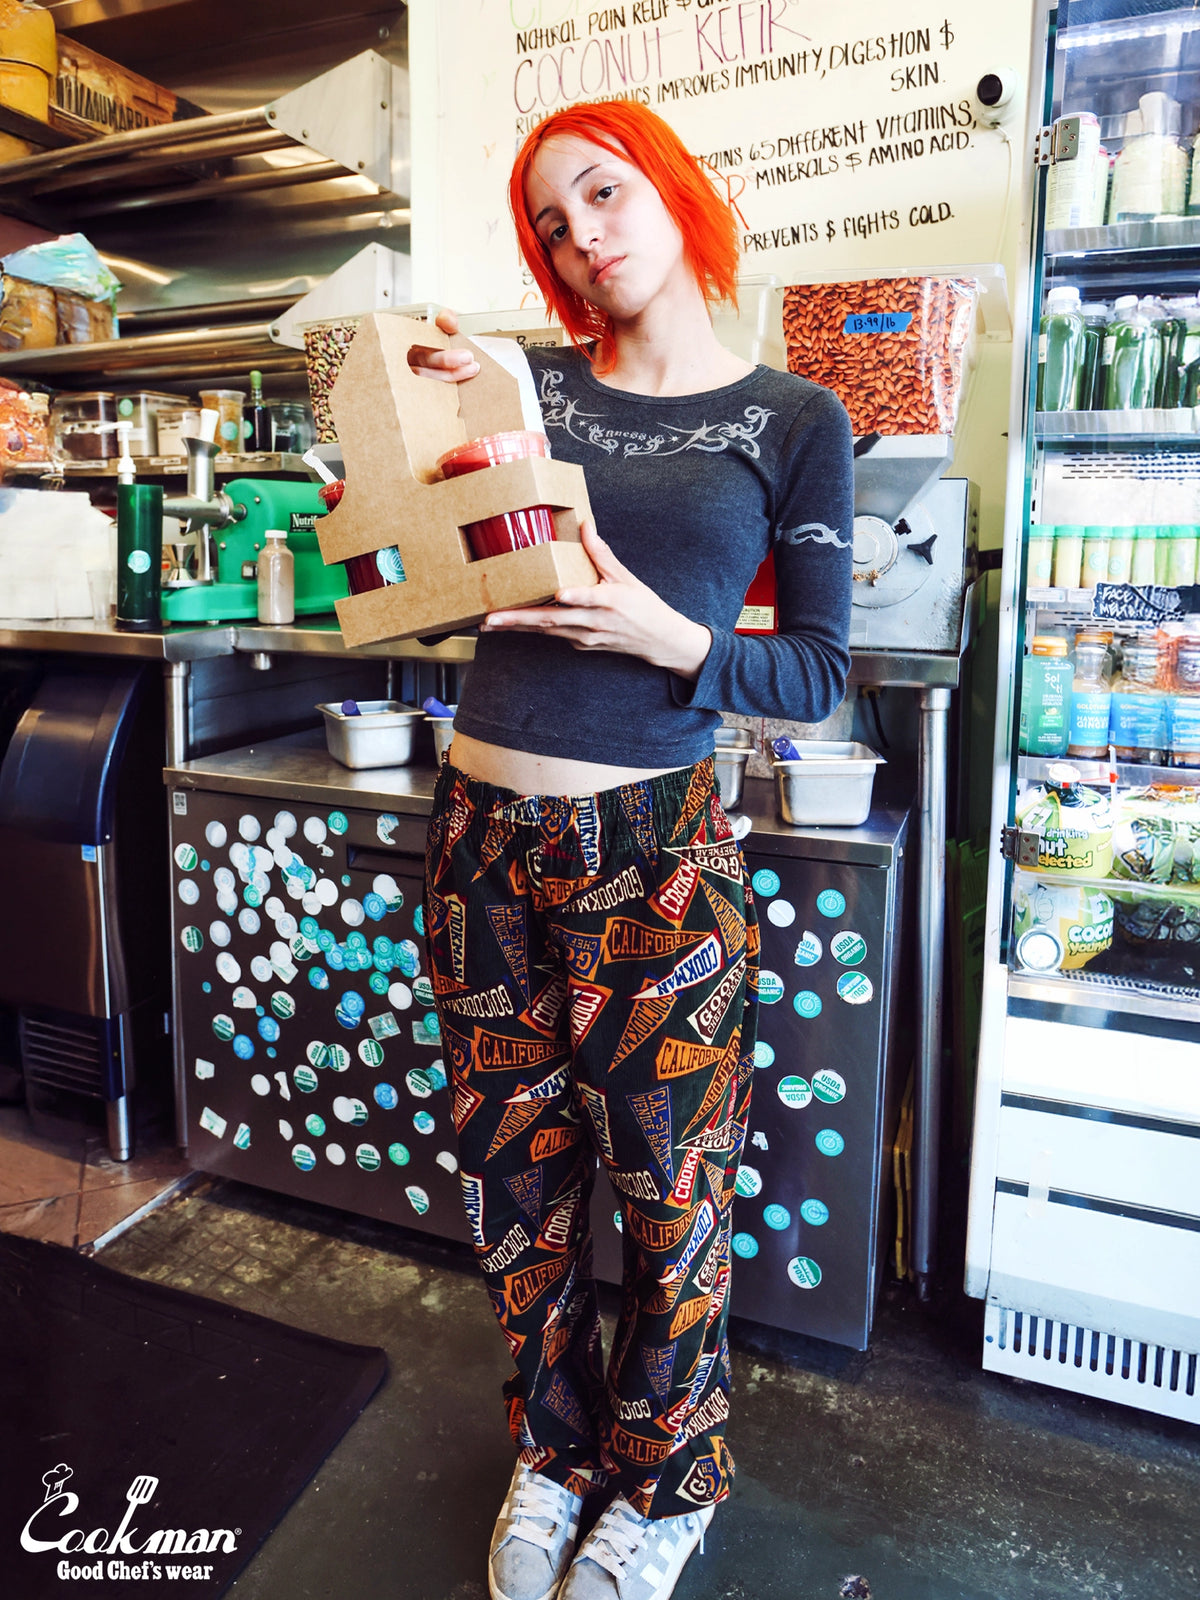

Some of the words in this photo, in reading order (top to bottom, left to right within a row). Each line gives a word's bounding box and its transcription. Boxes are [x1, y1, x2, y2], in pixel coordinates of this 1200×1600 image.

[588, 6, 626, 35] PAIN
[514, 27, 684, 115] COCONUT
[695, 0, 812, 72] KEFIR
[657, 69, 731, 104] IMPROVES
[756, 153, 840, 189] MINERALS
[868, 138, 925, 166] AMINO
[743, 222, 819, 253] PREVENTS
[843, 209, 900, 240] FIGHTS
[449, 899, 465, 980] COOKMAN
[612, 923, 698, 956] CALIFORNIA
[834, 935, 855, 953] USDA
[657, 941, 718, 996] COOKMAN
[659, 1041, 725, 1075] CALIFORNI
[820, 1073, 841, 1091] USDA
[785, 1092, 807, 1102] USDA
[631, 1094, 655, 1131] VENICE
[647, 1130, 668, 1165] BEACH
[647, 1088, 672, 1162] CAL-STATE
[674, 1148, 700, 1200] COOKM
[675, 1205, 713, 1275] COOKMAN
[684, 1385, 729, 1440] GO!COOKM
